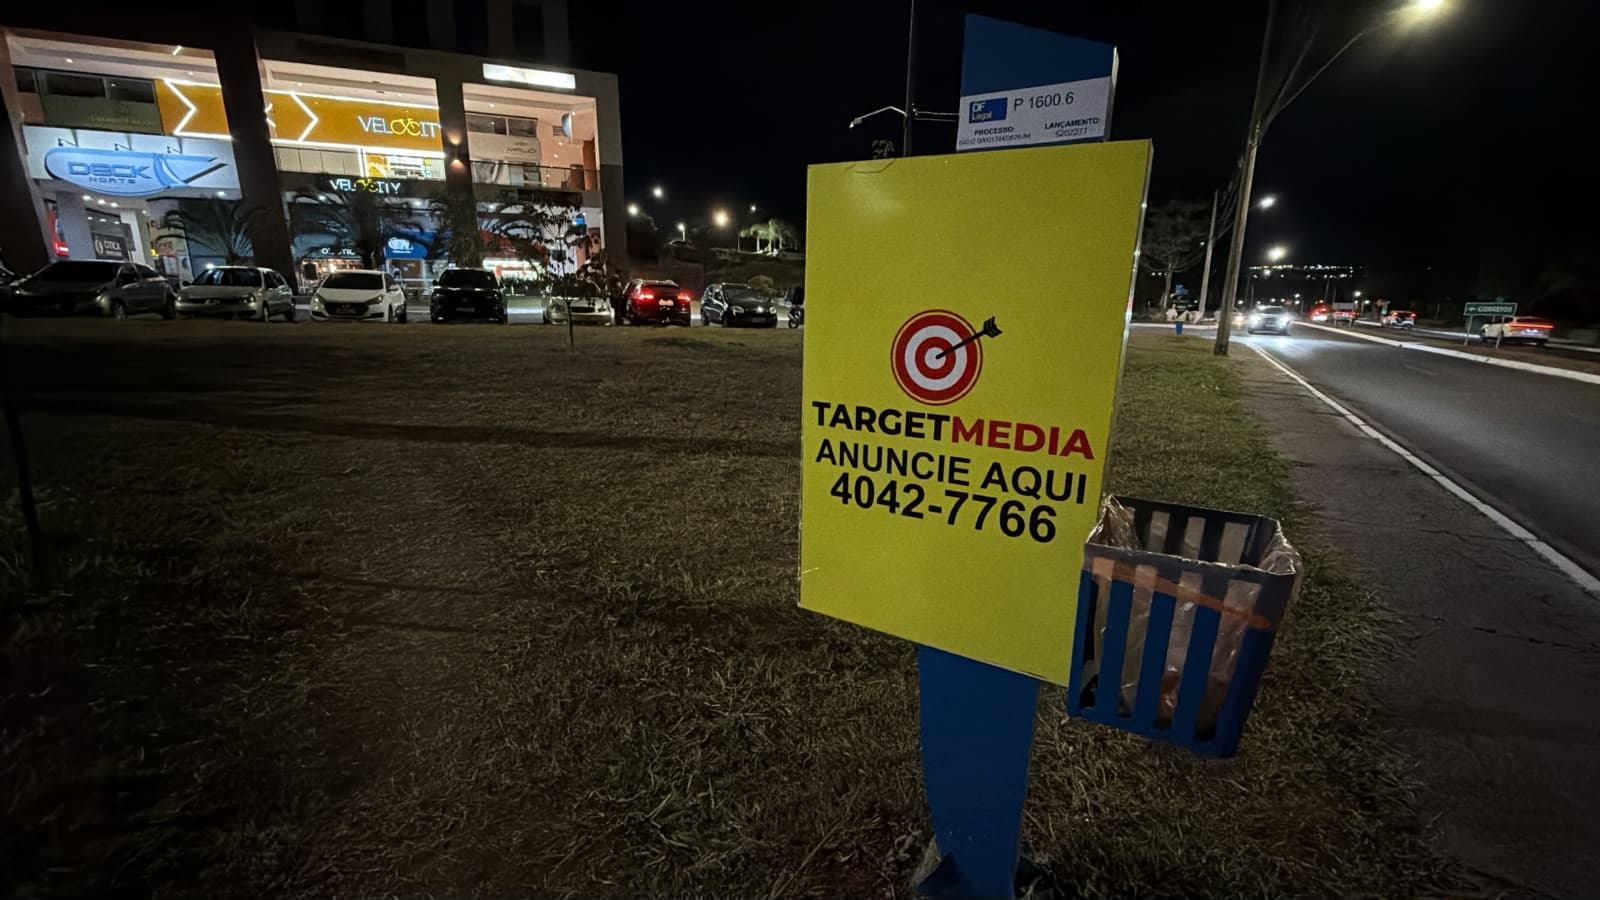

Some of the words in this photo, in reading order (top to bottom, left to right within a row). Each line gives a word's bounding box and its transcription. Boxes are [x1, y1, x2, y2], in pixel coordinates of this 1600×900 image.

[972, 101, 986, 112] DF
[1013, 98, 1024, 111] P
[1029, 91, 1075, 109] 1600.6
[357, 115, 442, 138] VELOCIT
[67, 161, 152, 179] DECK
[88, 176, 136, 184] NORTE
[815, 438, 971, 487] ANUNCIE
[980, 462, 1087, 504] AQUI
[830, 472, 1057, 543] 4042-7766
